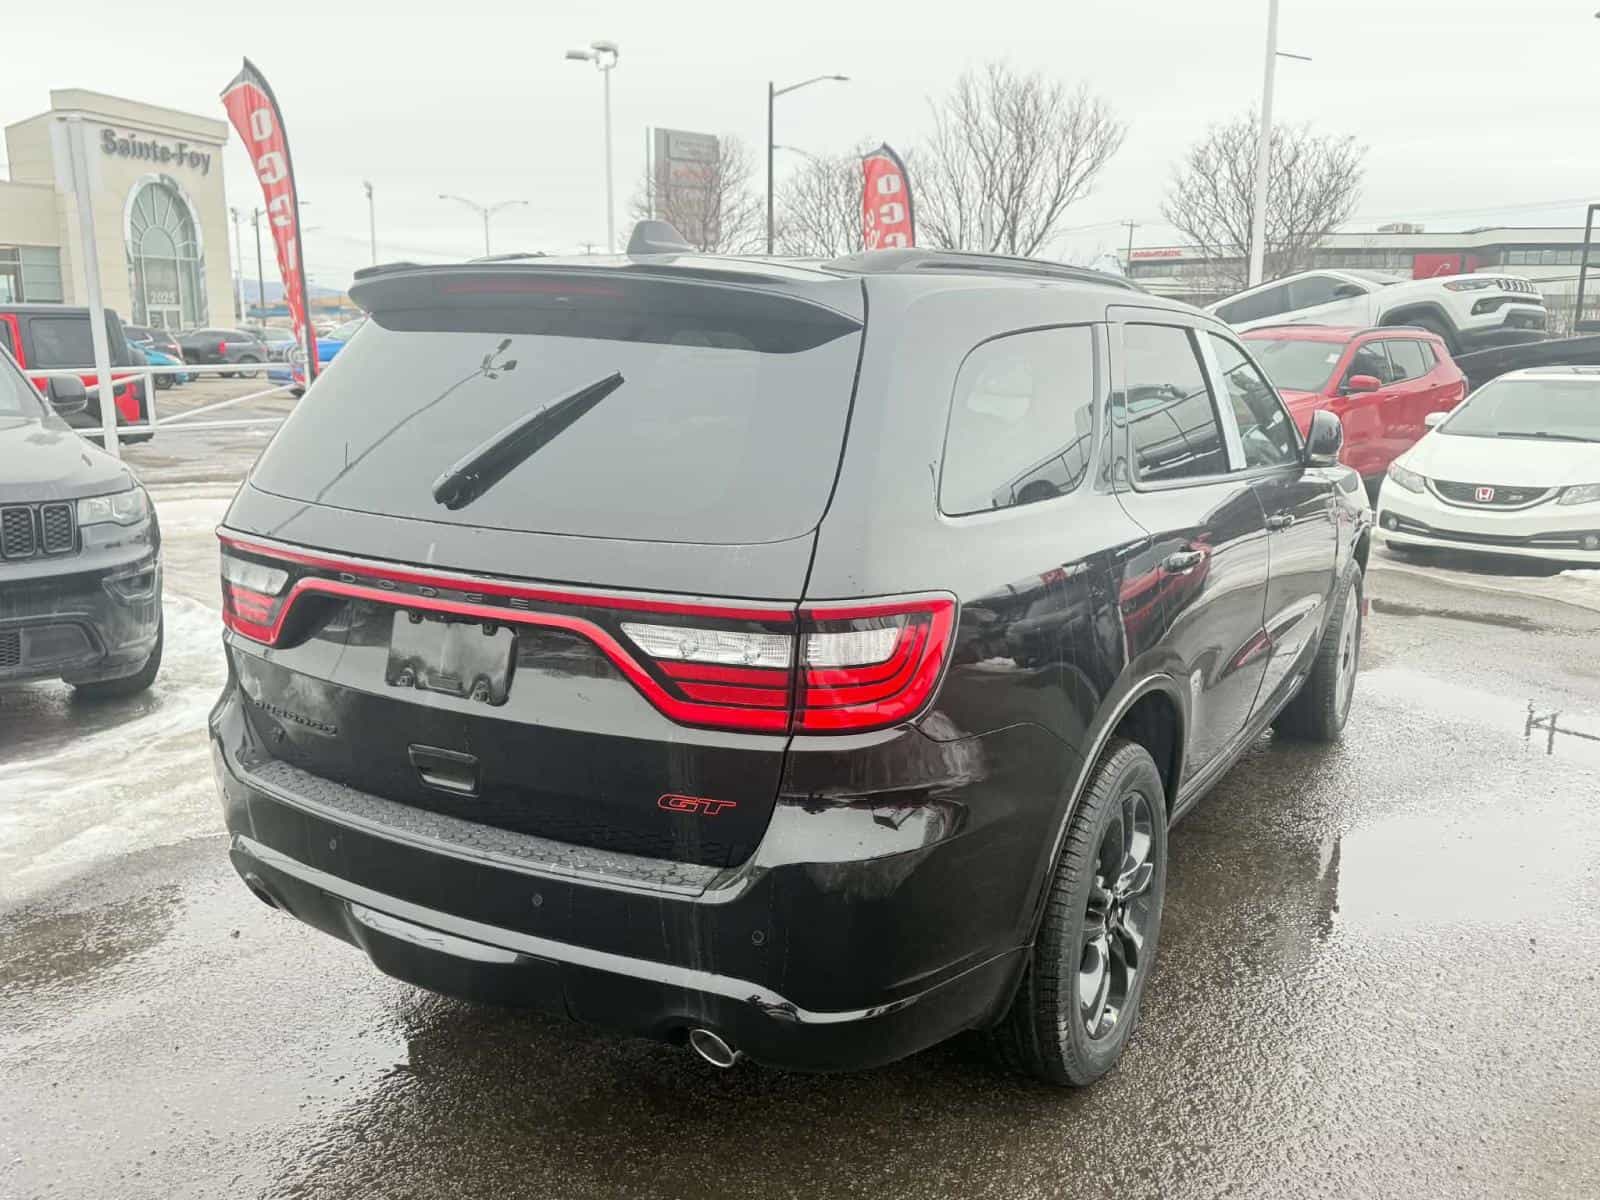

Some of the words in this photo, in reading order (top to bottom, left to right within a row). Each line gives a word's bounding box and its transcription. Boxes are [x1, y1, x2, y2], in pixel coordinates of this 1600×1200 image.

[101, 128, 211, 176] Sainte-Foy
[339, 572, 529, 610] DODGE
[657, 793, 737, 815] GT
